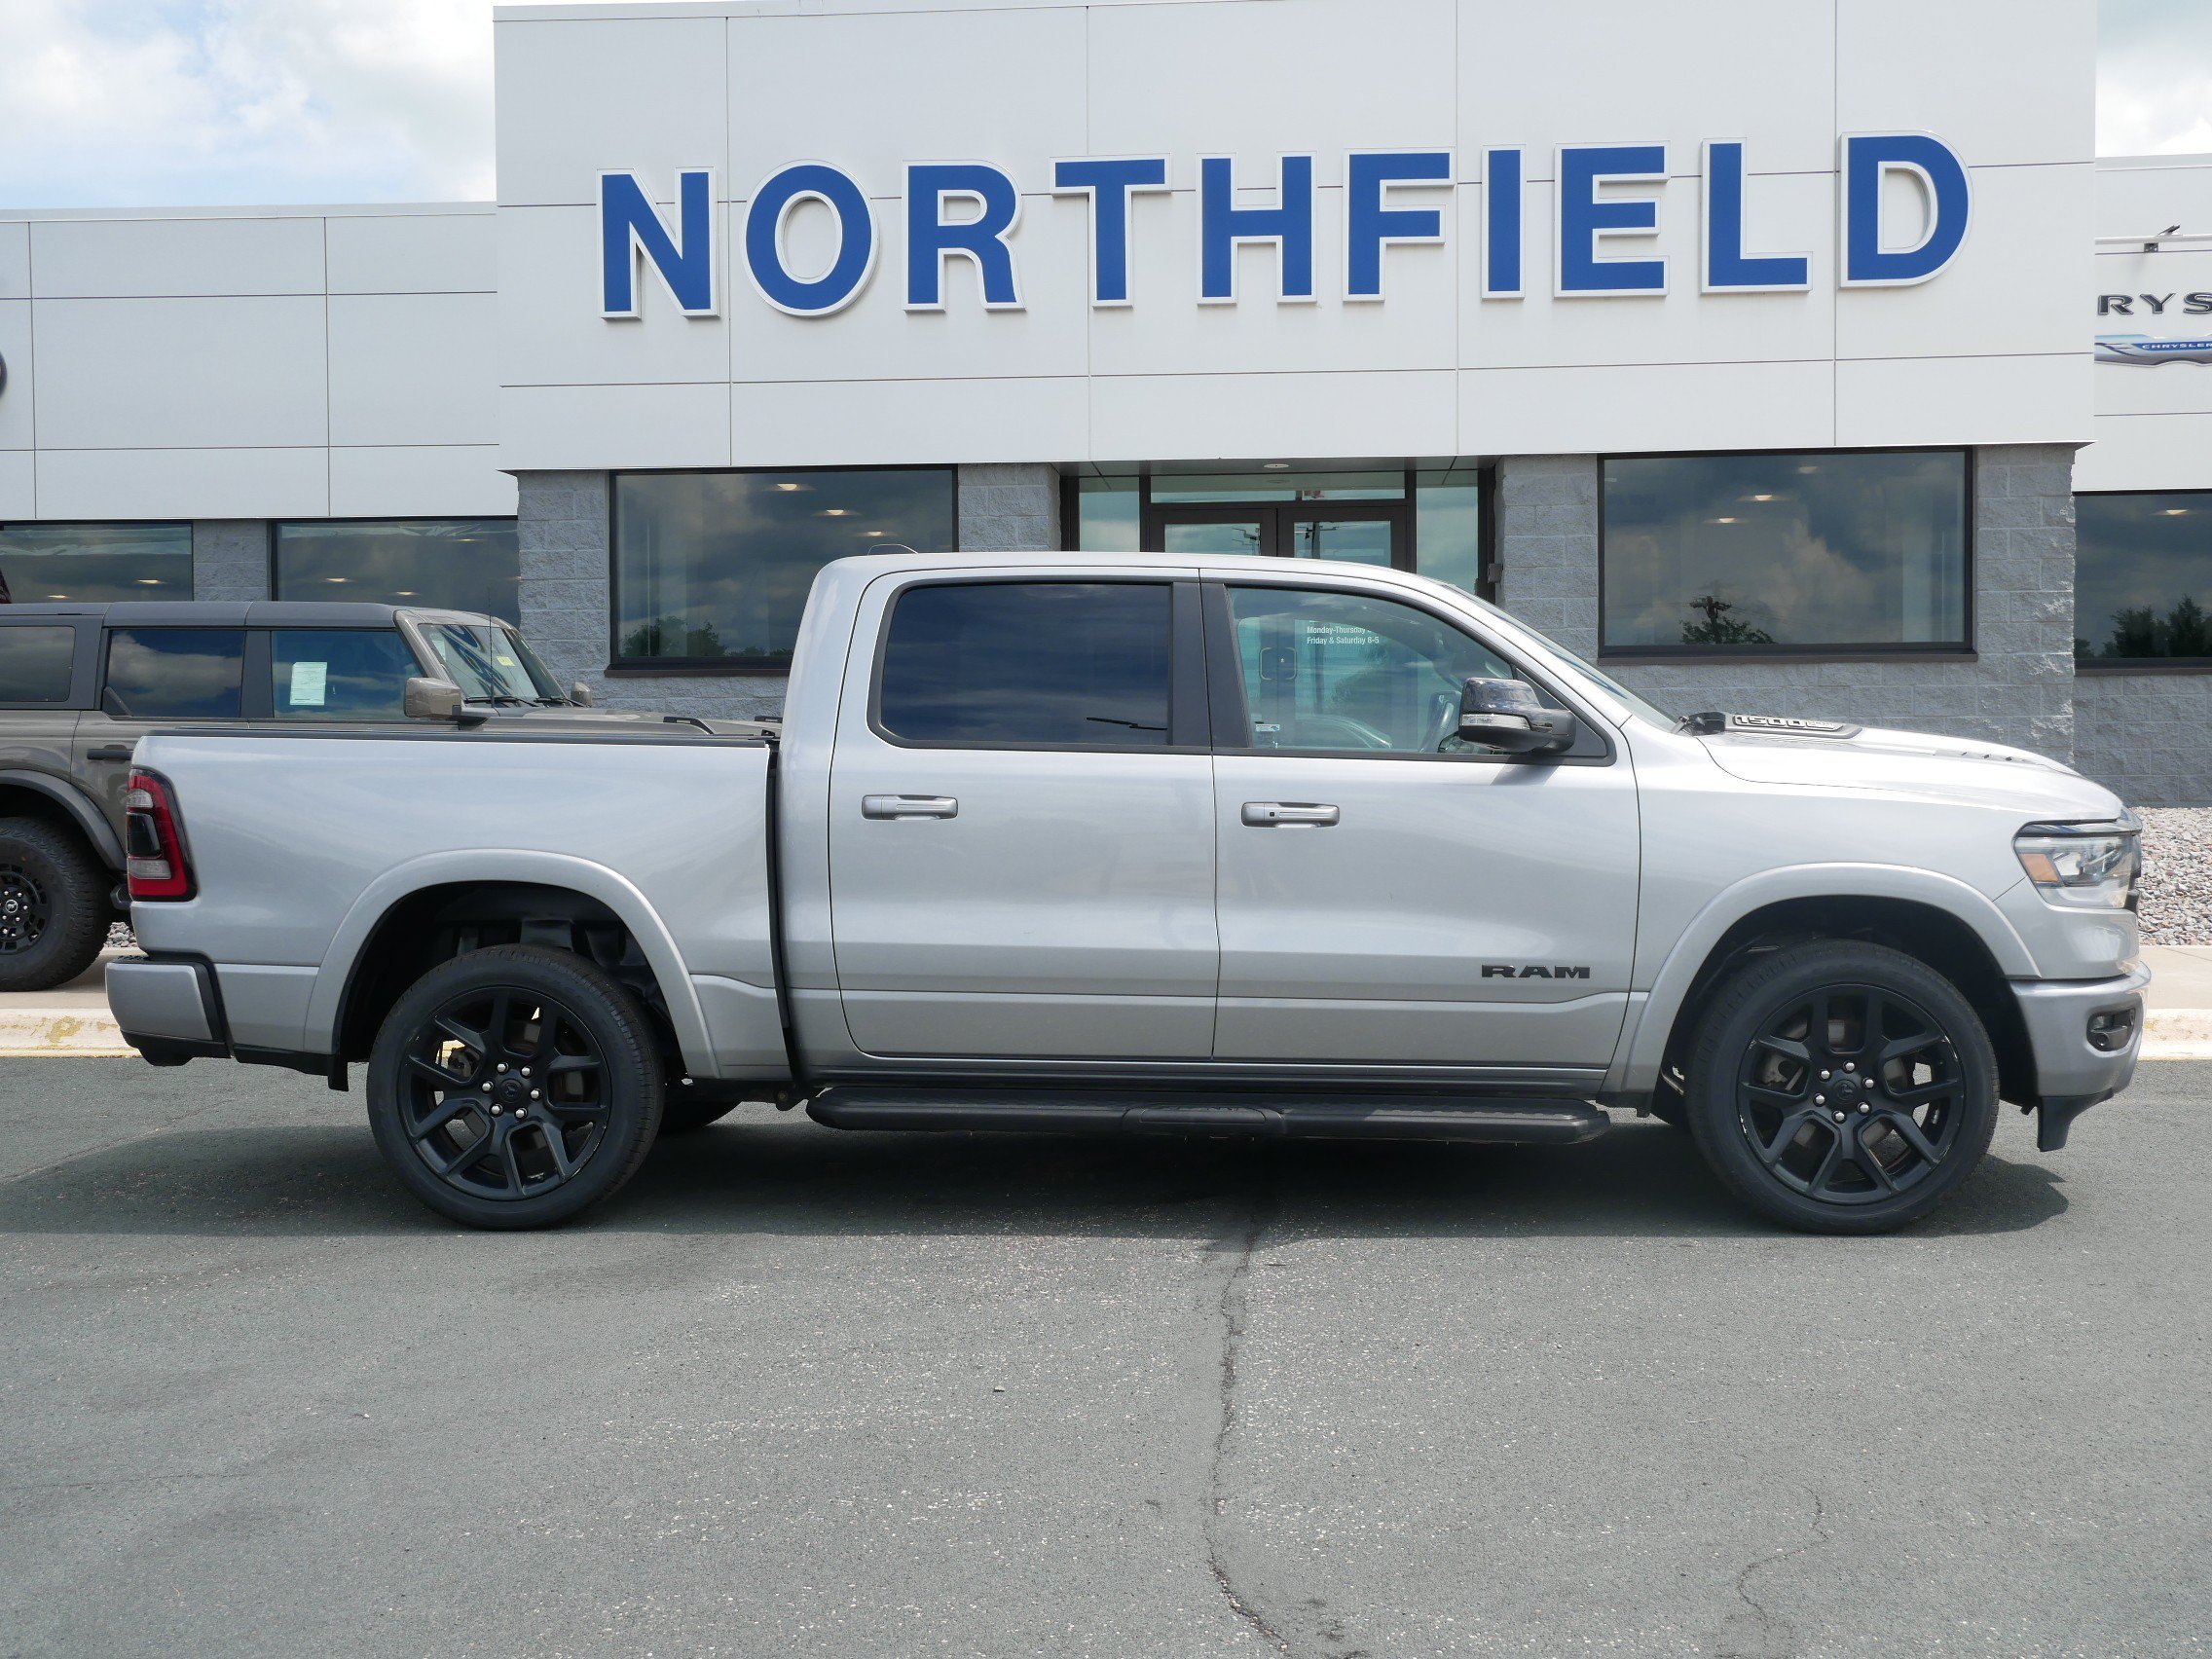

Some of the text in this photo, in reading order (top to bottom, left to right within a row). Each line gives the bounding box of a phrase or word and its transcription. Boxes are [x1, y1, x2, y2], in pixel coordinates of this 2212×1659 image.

[600, 132, 1972, 315] NORTHFIELD
[1307, 626, 1366, 635] Monday-Thursday
[1307, 637, 1328, 645] Friday
[1733, 714, 1806, 728] 1500
[1482, 965, 1590, 978] RAM
